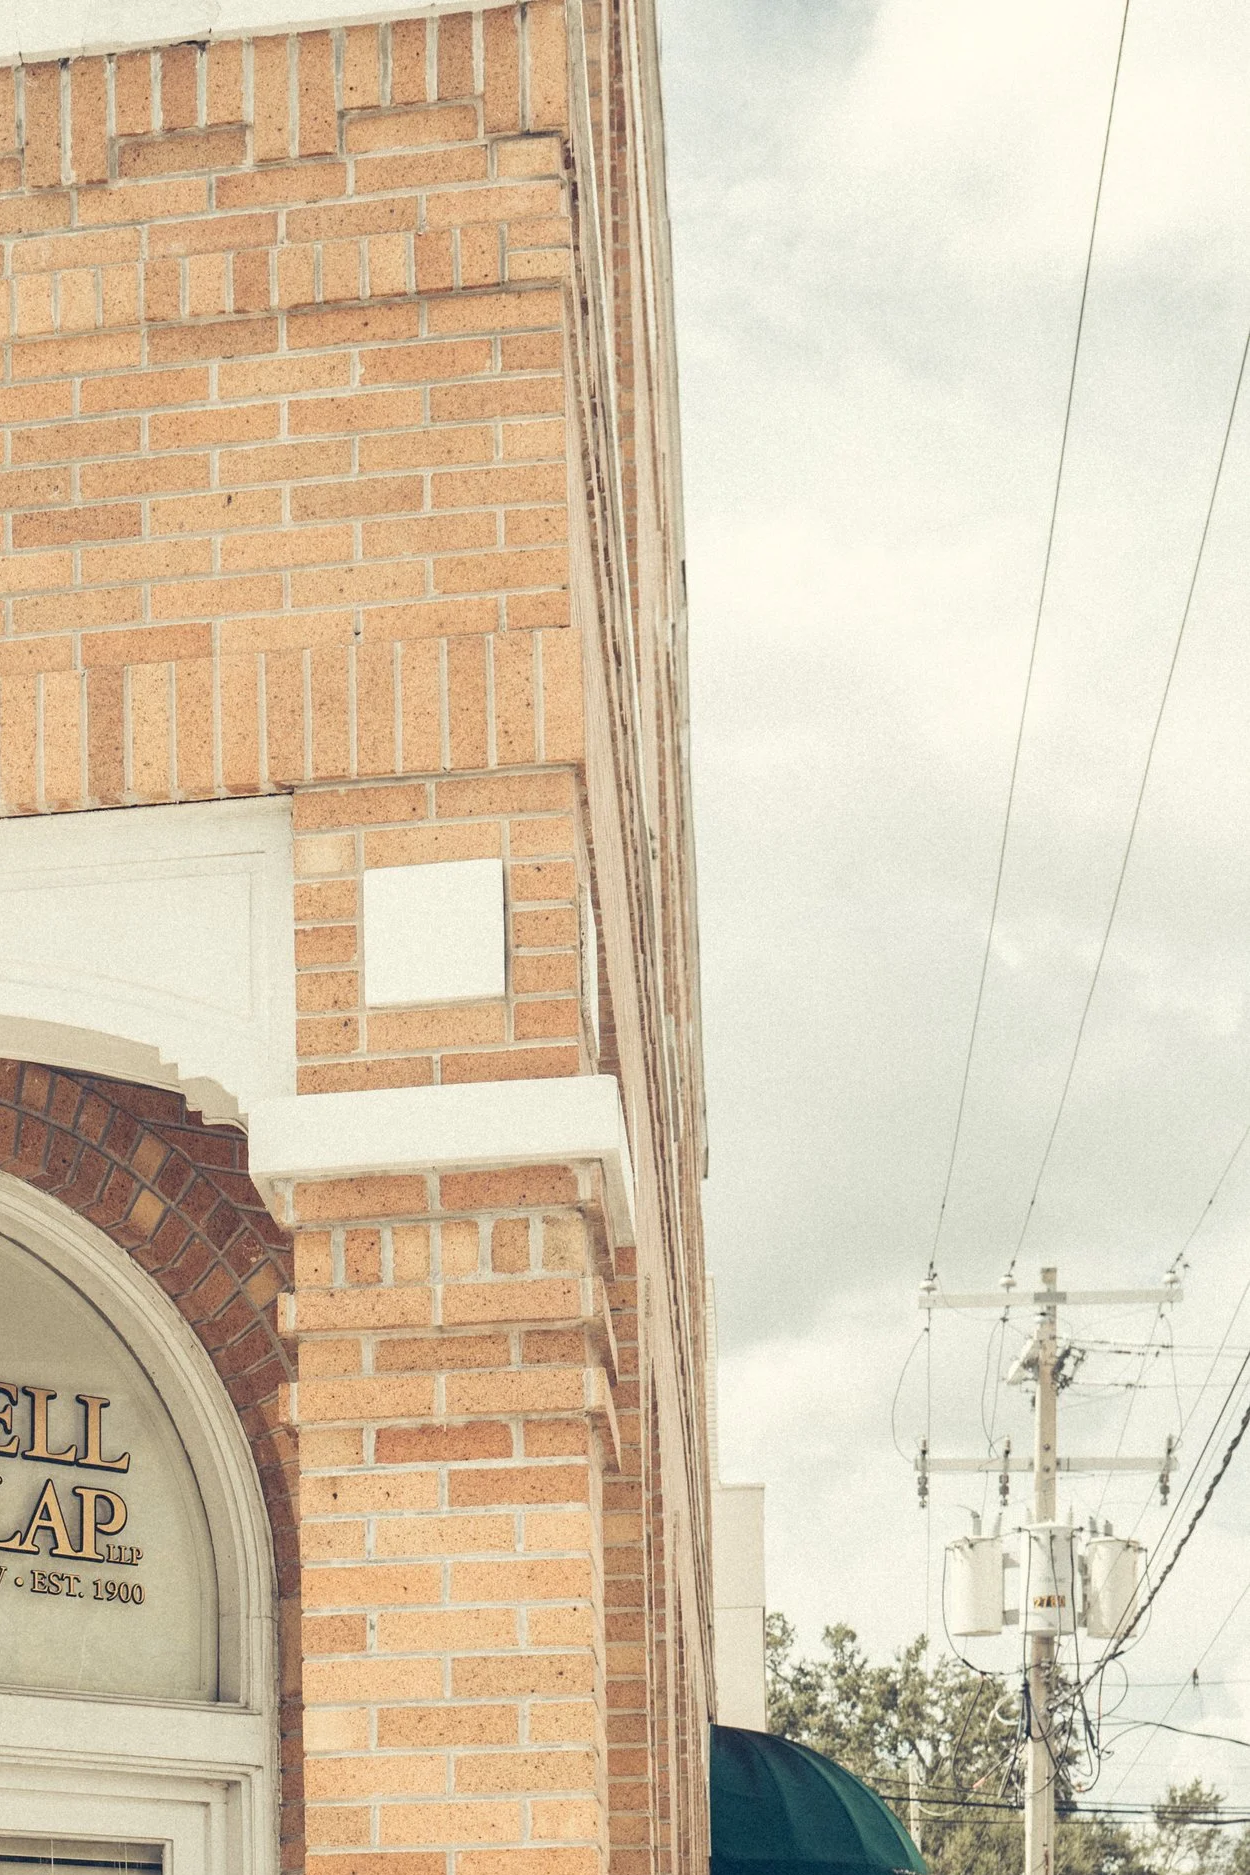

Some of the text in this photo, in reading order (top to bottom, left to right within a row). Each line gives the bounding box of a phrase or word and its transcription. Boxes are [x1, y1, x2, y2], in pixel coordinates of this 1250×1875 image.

[105, 1543, 144, 1566] LLP
[30, 1570, 85, 1599] EST.
[93, 1577, 146, 1605] 1900
